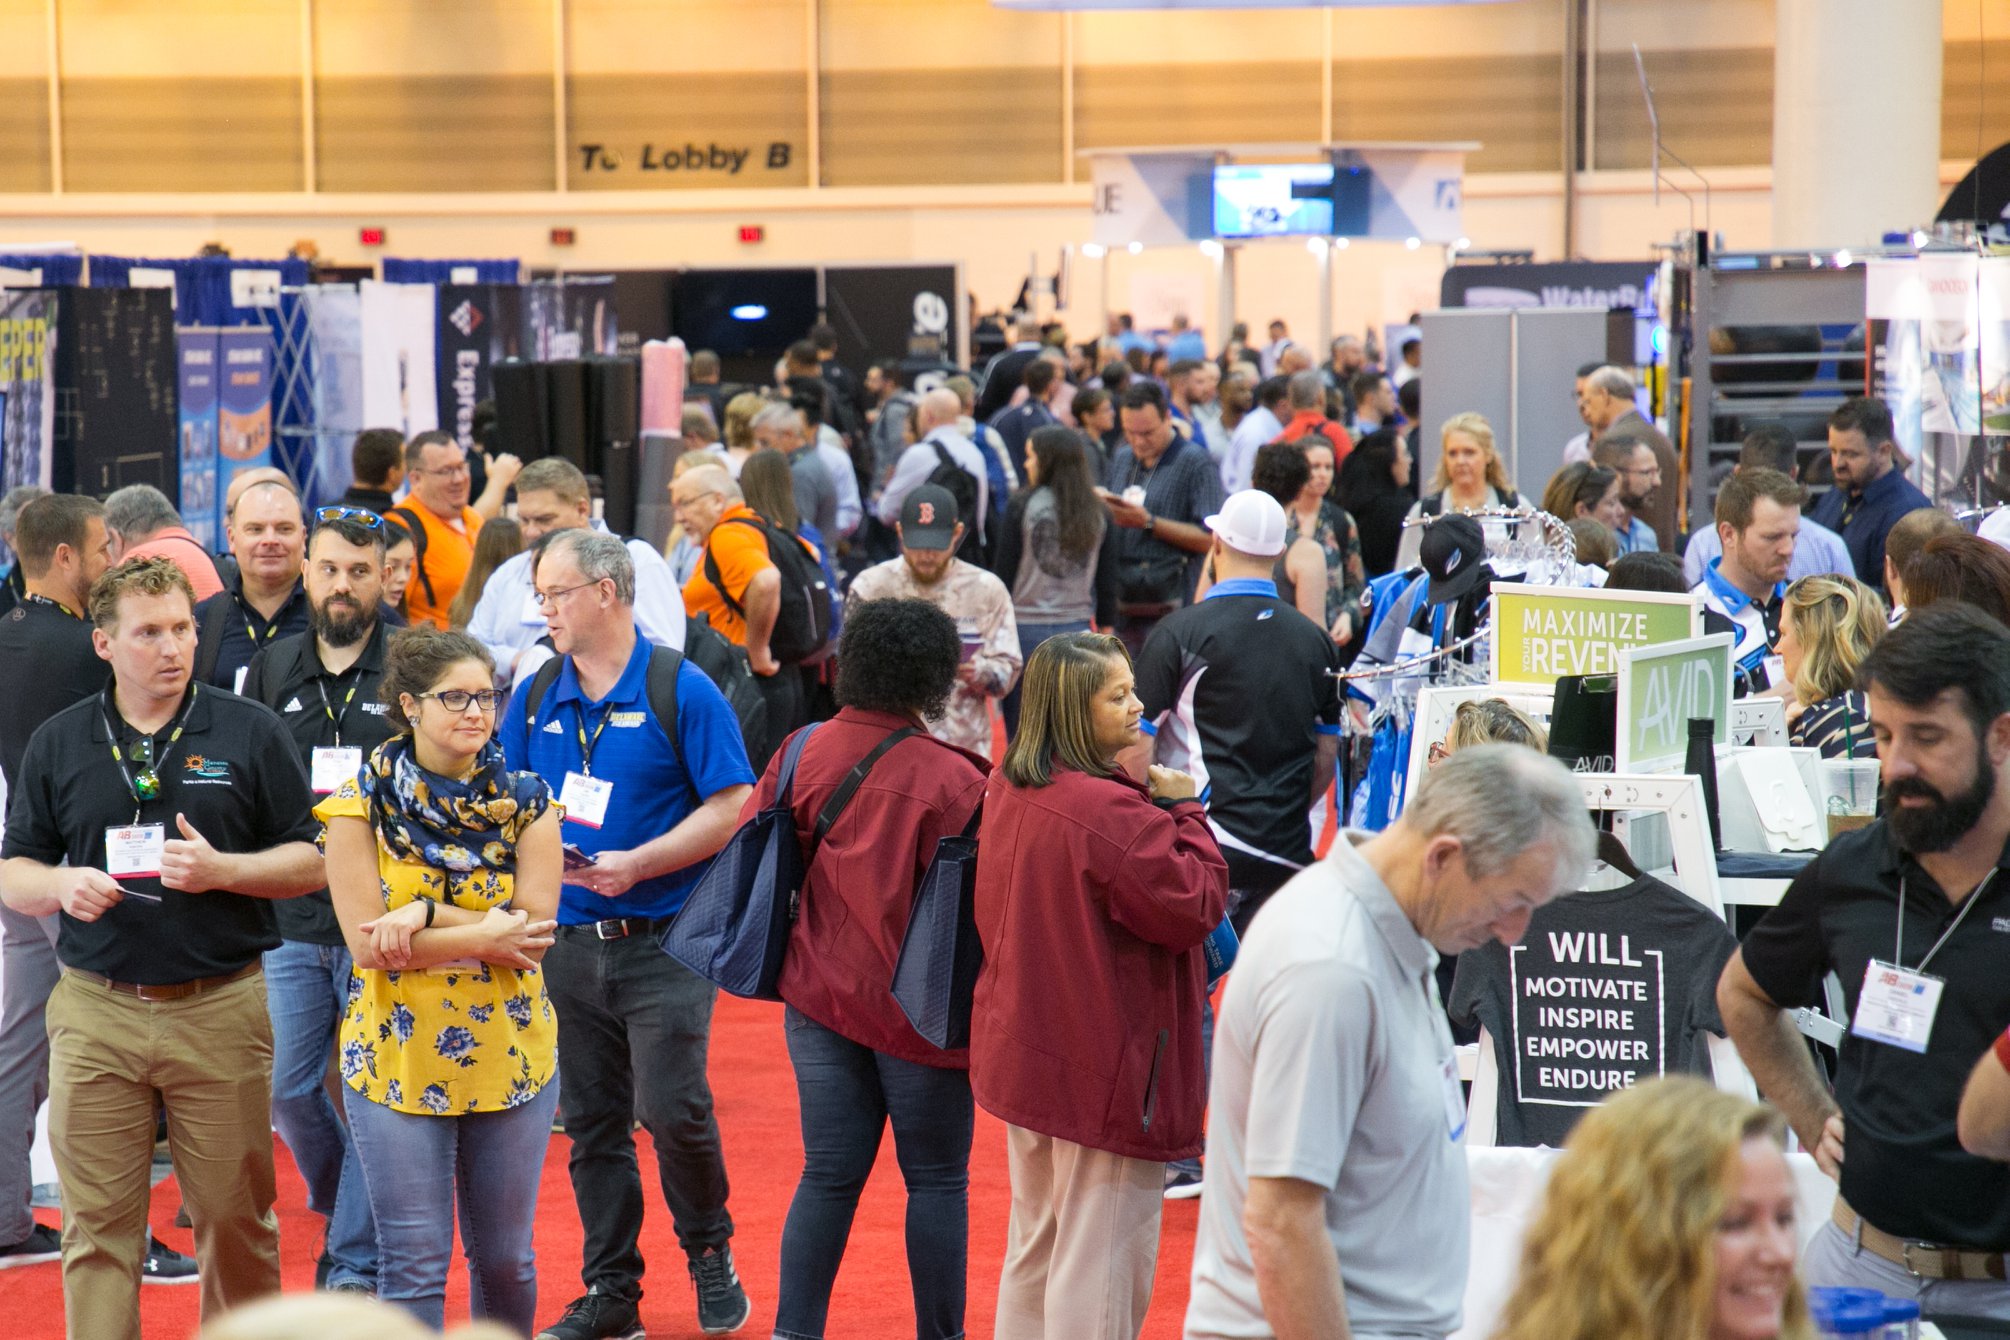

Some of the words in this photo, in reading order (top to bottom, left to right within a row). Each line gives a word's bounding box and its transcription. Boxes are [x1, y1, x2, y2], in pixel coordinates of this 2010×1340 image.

[641, 144, 748, 174] Lobby
[767, 142, 792, 169] B
[918, 502, 935, 524] B
[1523, 608, 1648, 640] MAXIMIZE
[1522, 637, 1531, 673] YOUR
[1531, 637, 1650, 675] REVEN
[1639, 658, 1715, 751] AVID
[1573, 755, 1614, 773] AVID
[1548, 931, 1643, 968] WILL
[1525, 977, 1648, 1001] MOTIVATE
[1539, 1007, 1635, 1030] INSPIRE
[1526, 1037, 1650, 1061] EMPOWER
[1539, 1067, 1637, 1090] ENDURE
